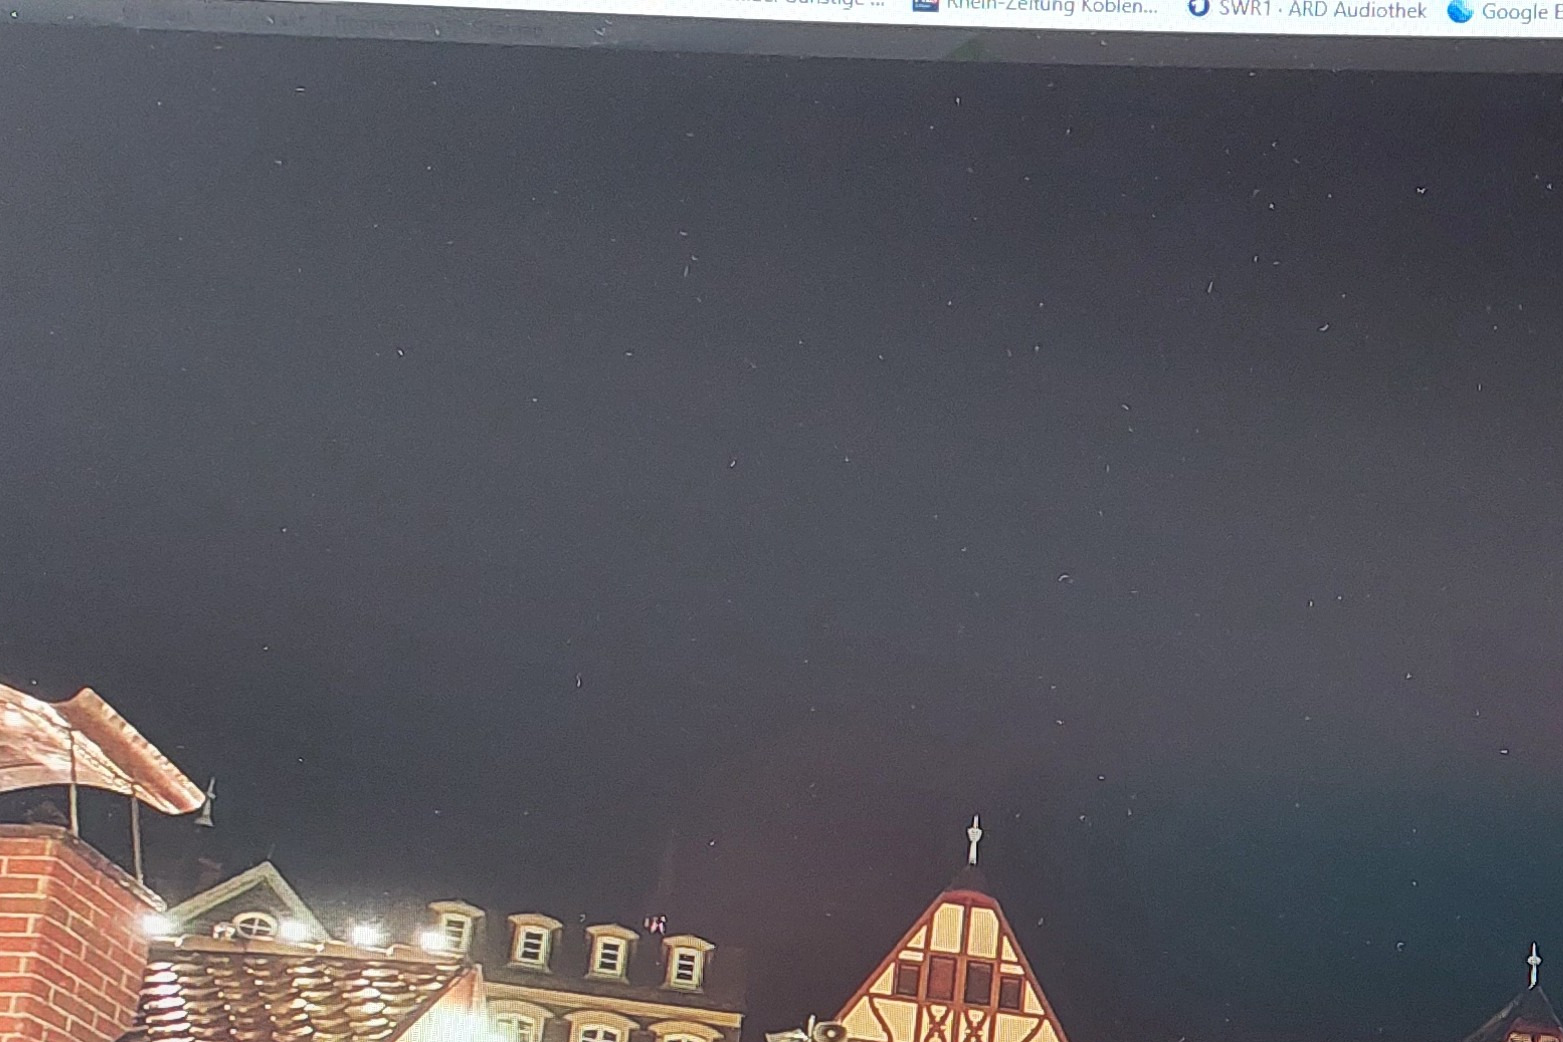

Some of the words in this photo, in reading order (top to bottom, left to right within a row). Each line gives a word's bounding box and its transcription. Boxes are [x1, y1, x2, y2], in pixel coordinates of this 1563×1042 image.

[946, 0, 1074, 16] Rhein-Zeitung
[1082, 0, 1158, 14] Koblen...
[1219, 0, 1271, 16] SWR1
[1288, 0, 1328, 18] ARD
[1333, 1, 1428, 19] Audiothek
[1482, 3, 1548, 24] Google
